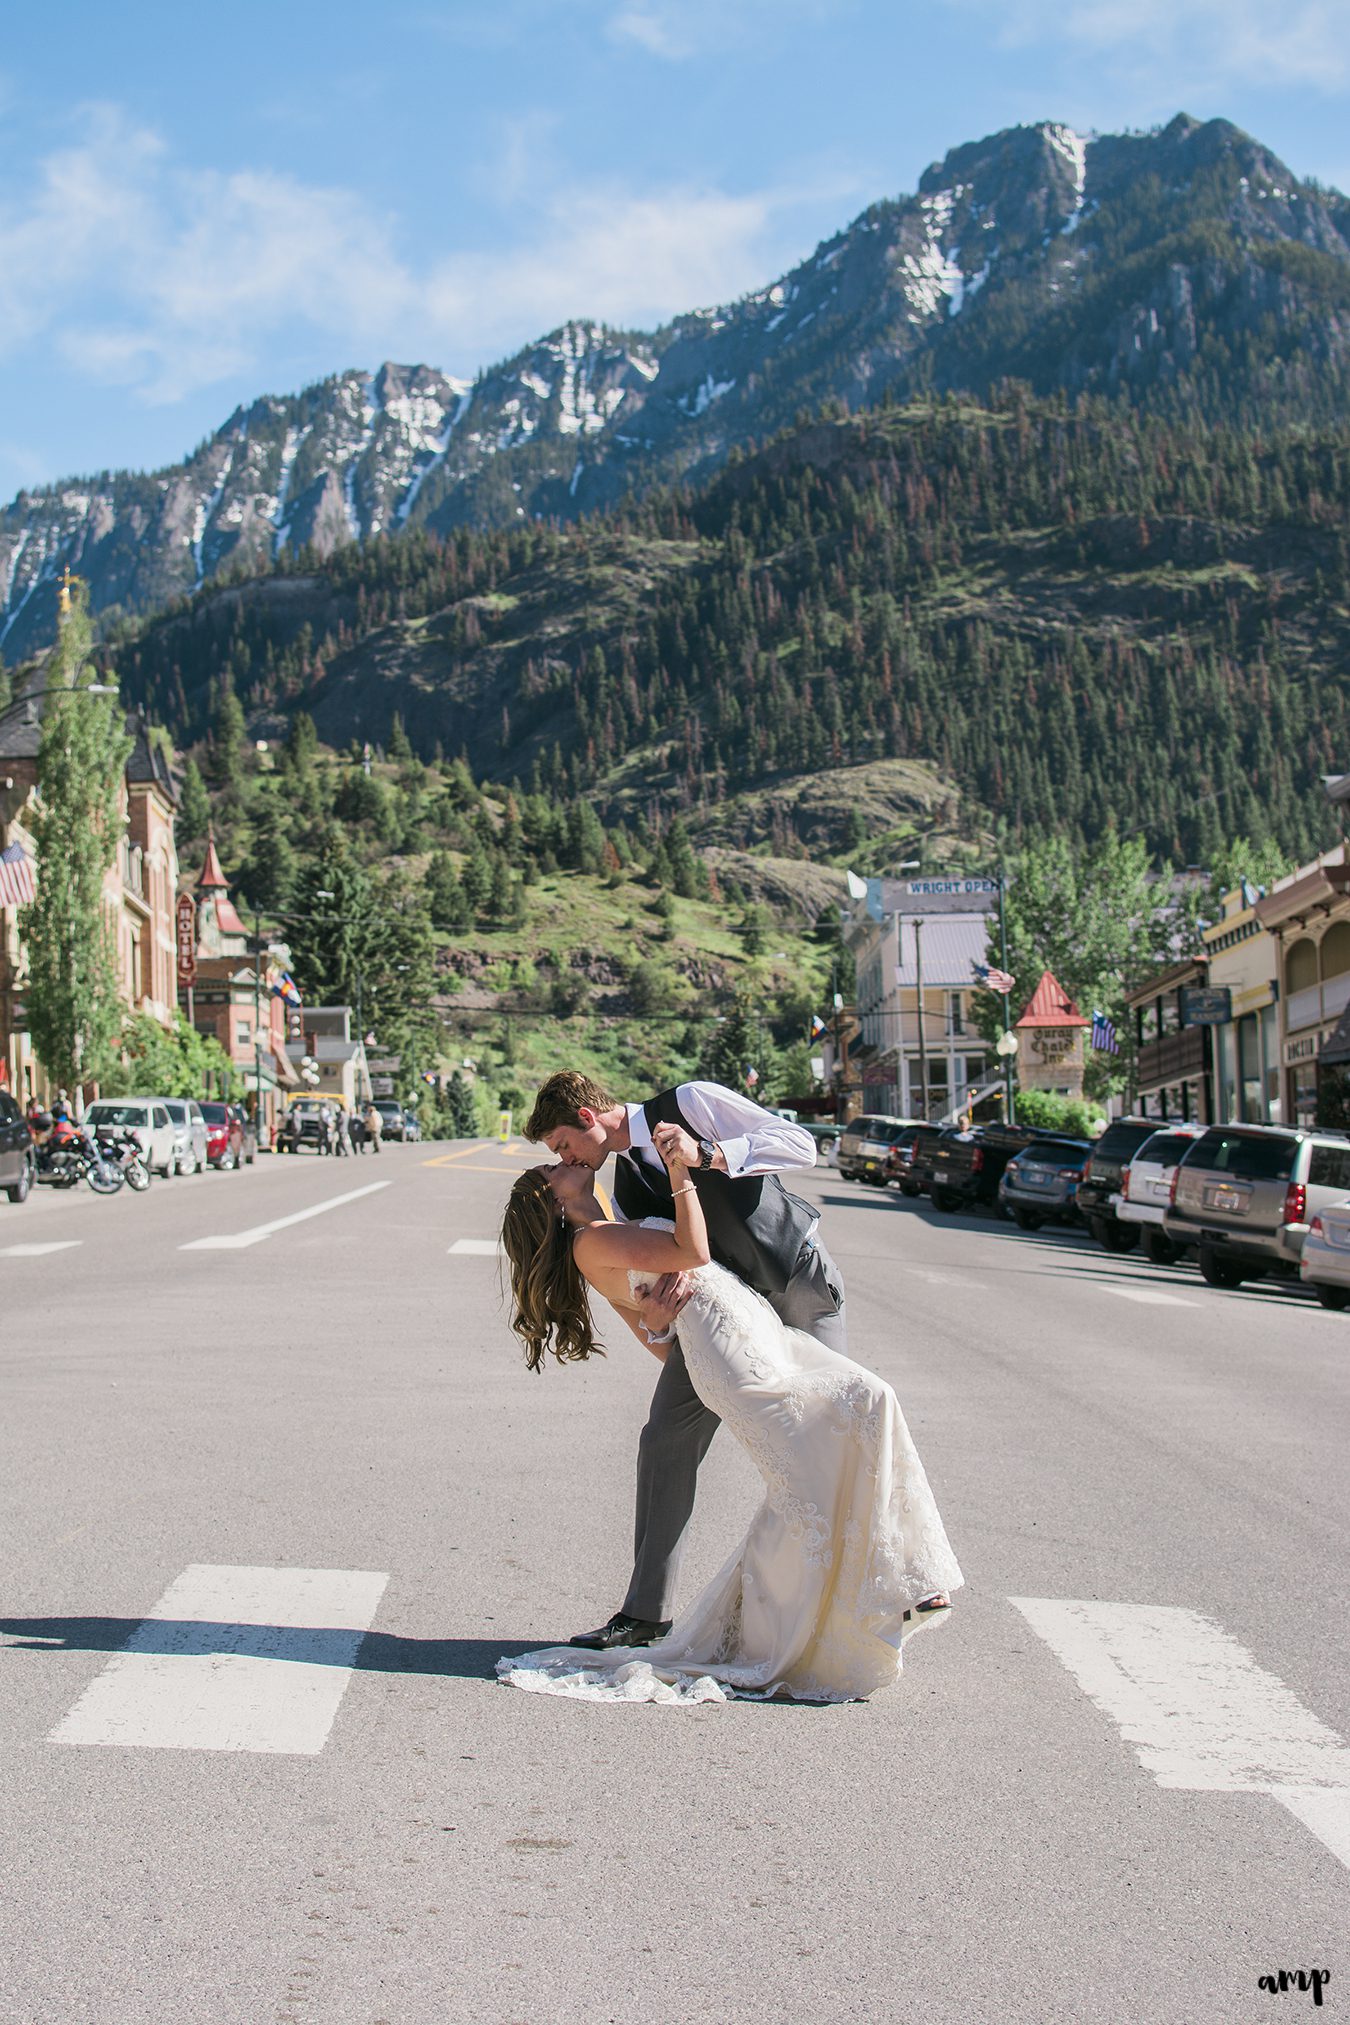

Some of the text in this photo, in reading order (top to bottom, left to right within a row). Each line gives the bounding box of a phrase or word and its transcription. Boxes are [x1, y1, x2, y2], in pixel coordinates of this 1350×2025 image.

[910, 881, 961, 894] WRIGHT
[180, 907, 192, 969] HOTEL
[1033, 1028, 1073, 1042] Ouray
